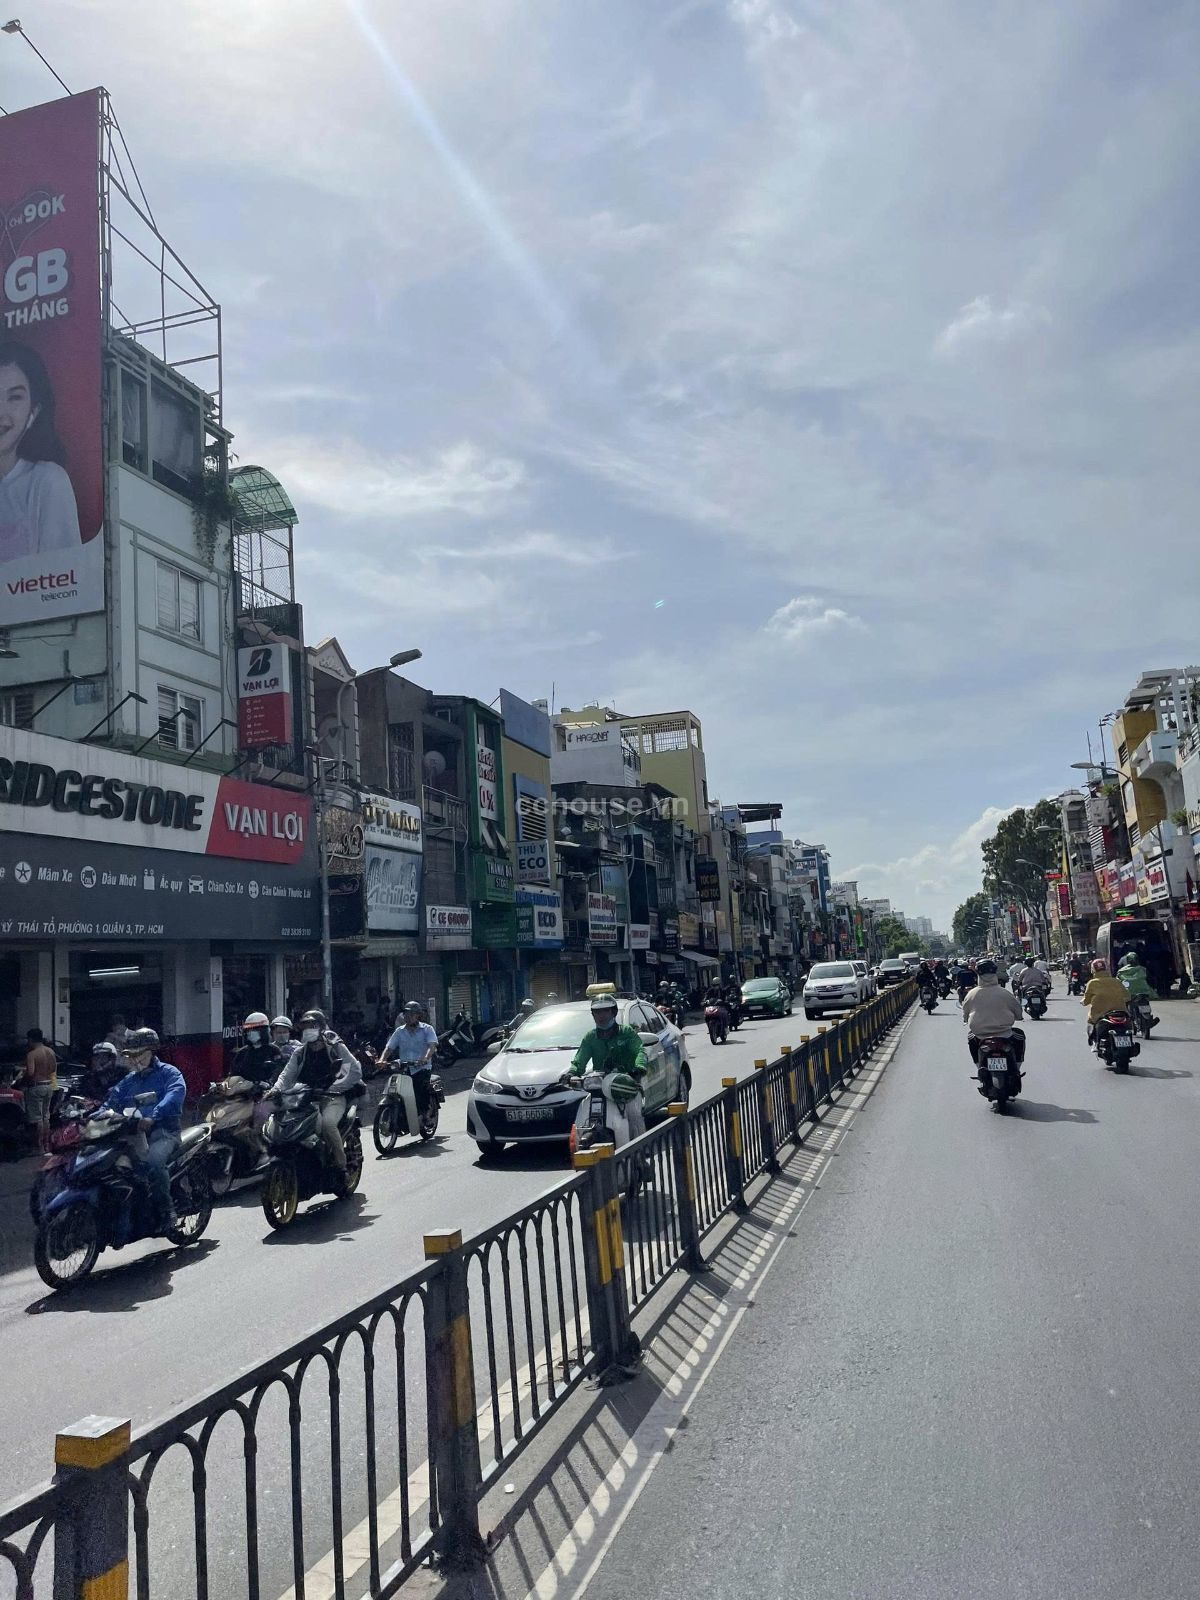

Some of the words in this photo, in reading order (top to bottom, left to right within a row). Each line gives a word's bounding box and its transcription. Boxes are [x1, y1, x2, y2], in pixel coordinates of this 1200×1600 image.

[24, 194, 66, 223] 90K
[4, 247, 69, 304] GB
[4, 297, 69, 329] THÁNG
[7, 569, 78, 595] viettel
[41, 589, 78, 602] telecom
[224, 802, 268, 838] VẠN
[272, 811, 304, 847] LỢI
[539, 844, 545, 853] Y
[519, 857, 546, 870] ECO
[61, 869, 73, 882] Xe
[171, 881, 183, 892] quy
[236, 882, 244, 894] Xe
[368, 886, 416, 906] Achilles
[17, 920, 39, 933] THÁI
[43, 916, 56, 934] TỔ,
[58, 920, 93, 933] PHƯỜNG
[102, 921, 124, 934] QUẬN
[125, 924, 133, 935] 3,
[134, 924, 146, 934] TP.
[148, 924, 164, 934] HCM
[538, 911, 557, 928] ECO
